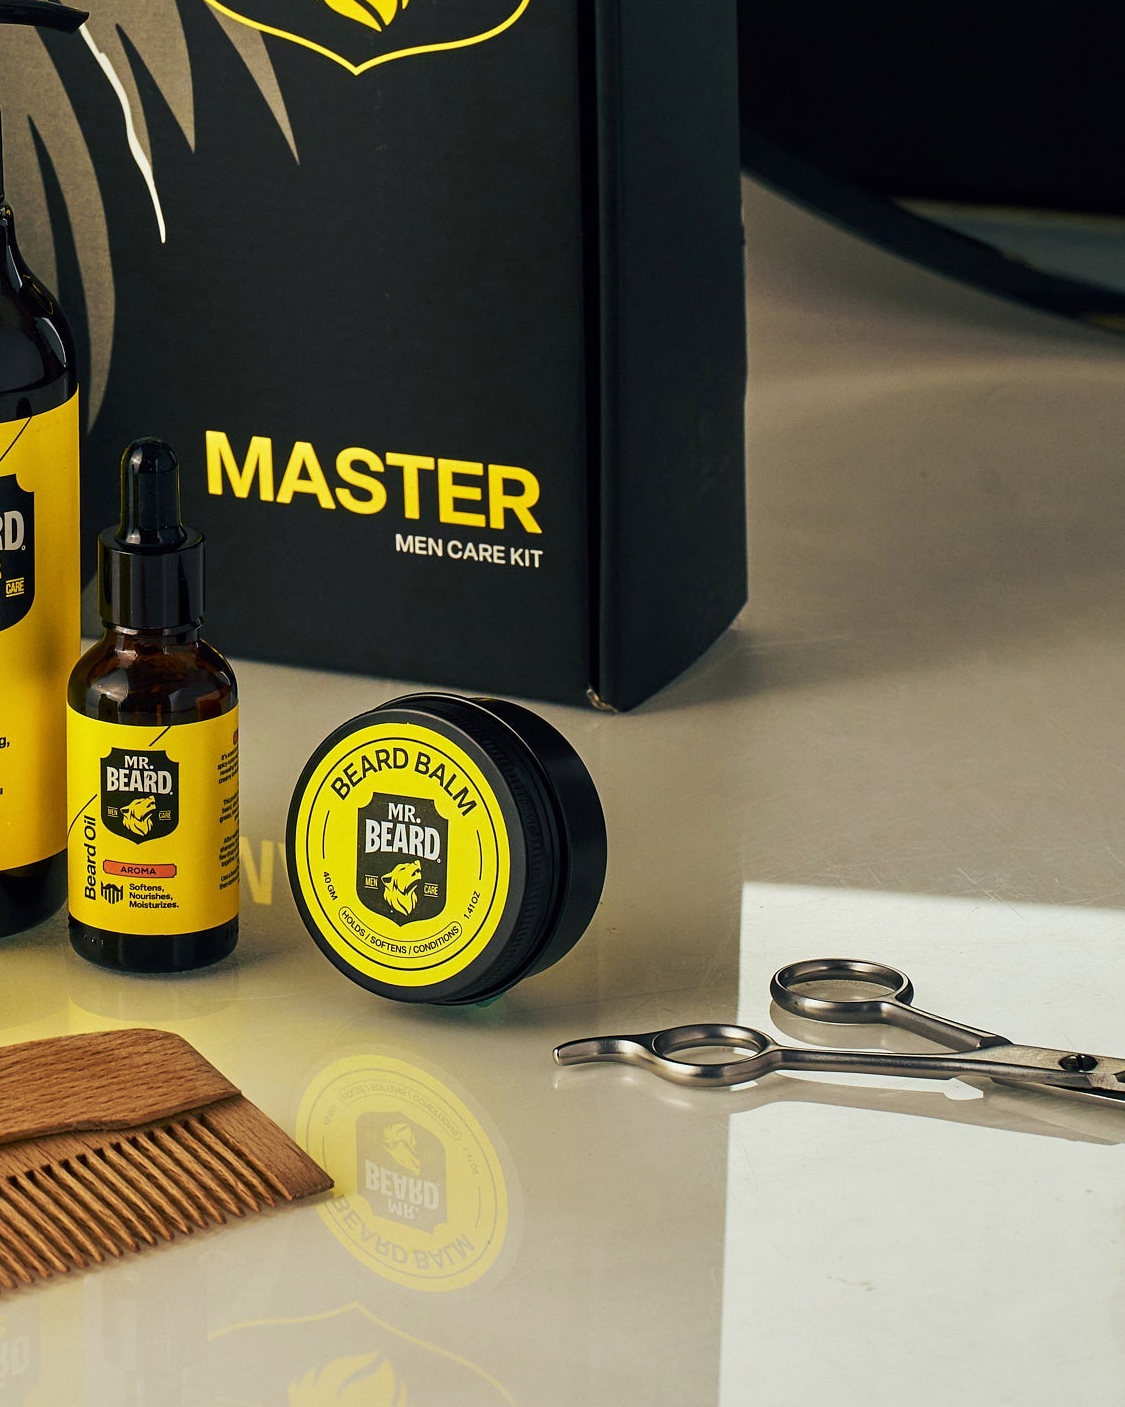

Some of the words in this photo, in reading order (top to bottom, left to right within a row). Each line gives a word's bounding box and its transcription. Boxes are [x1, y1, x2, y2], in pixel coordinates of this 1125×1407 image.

[205, 430, 543, 534] MASTER
[395, 533, 443, 559] MEN
[447, 539, 506, 565] CARE
[510, 547, 544, 568] KIT
[6, 580, 24, 595] CARE
[124, 755, 154, 770] MR.
[331, 747, 409, 800] BEARD
[414, 751, 478, 817] BALM
[388, 802, 421, 824] MR.
[84, 815, 97, 840] Oil
[84, 843, 97, 900] Beard
[120, 866, 156, 875] AROMA
[129, 883, 164, 892] Softens,
[323, 871, 331, 883] 40
[327, 884, 338, 901] GM
[365, 876, 378, 887] MEN
[129, 892, 173, 901] Nourishes,
[129, 900, 179, 909] Moisturizes.
[471, 891, 481, 904] OZ
[341, 910, 365, 936] HOLDS
[370, 936, 407, 953] SOFTENS
[413, 926, 459, 954] CONDITIONS
